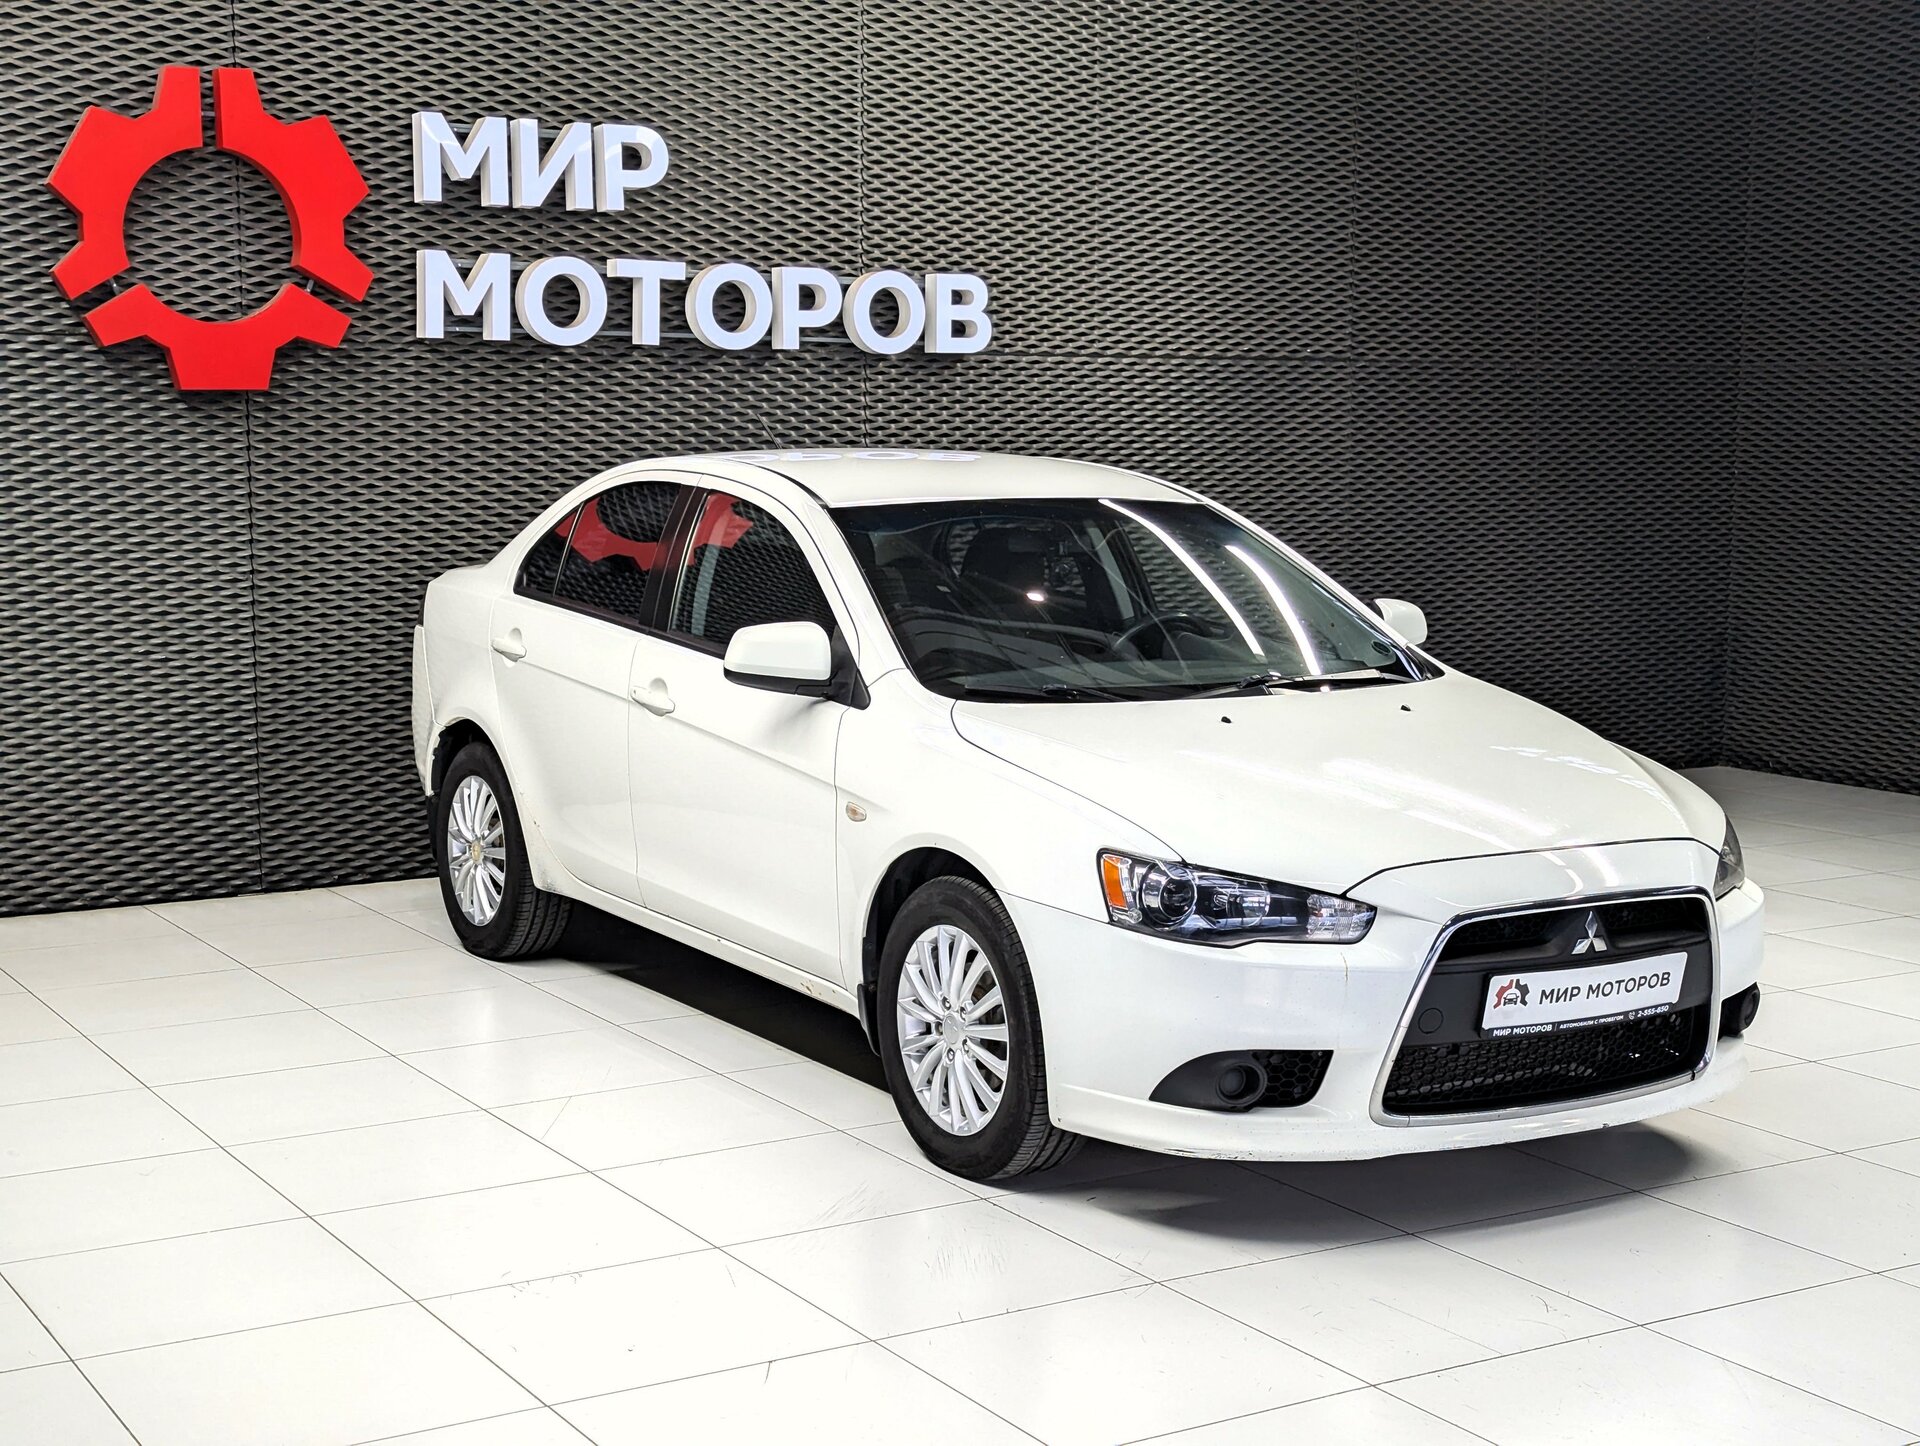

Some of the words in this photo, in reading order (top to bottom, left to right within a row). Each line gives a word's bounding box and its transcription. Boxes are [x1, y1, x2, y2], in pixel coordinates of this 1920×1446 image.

[412, 112, 669, 212] МИР
[416, 249, 993, 354] МОТОРОВ
[1539, 986, 1581, 1005] МИР
[1586, 972, 1671, 1000] МОТОРОВ
[1493, 1028, 1511, 1037] МИР
[1512, 1024, 1553, 1035] МОТОРОВ
[1559, 1020, 1594, 1029] АВТОМОБИЛИ
